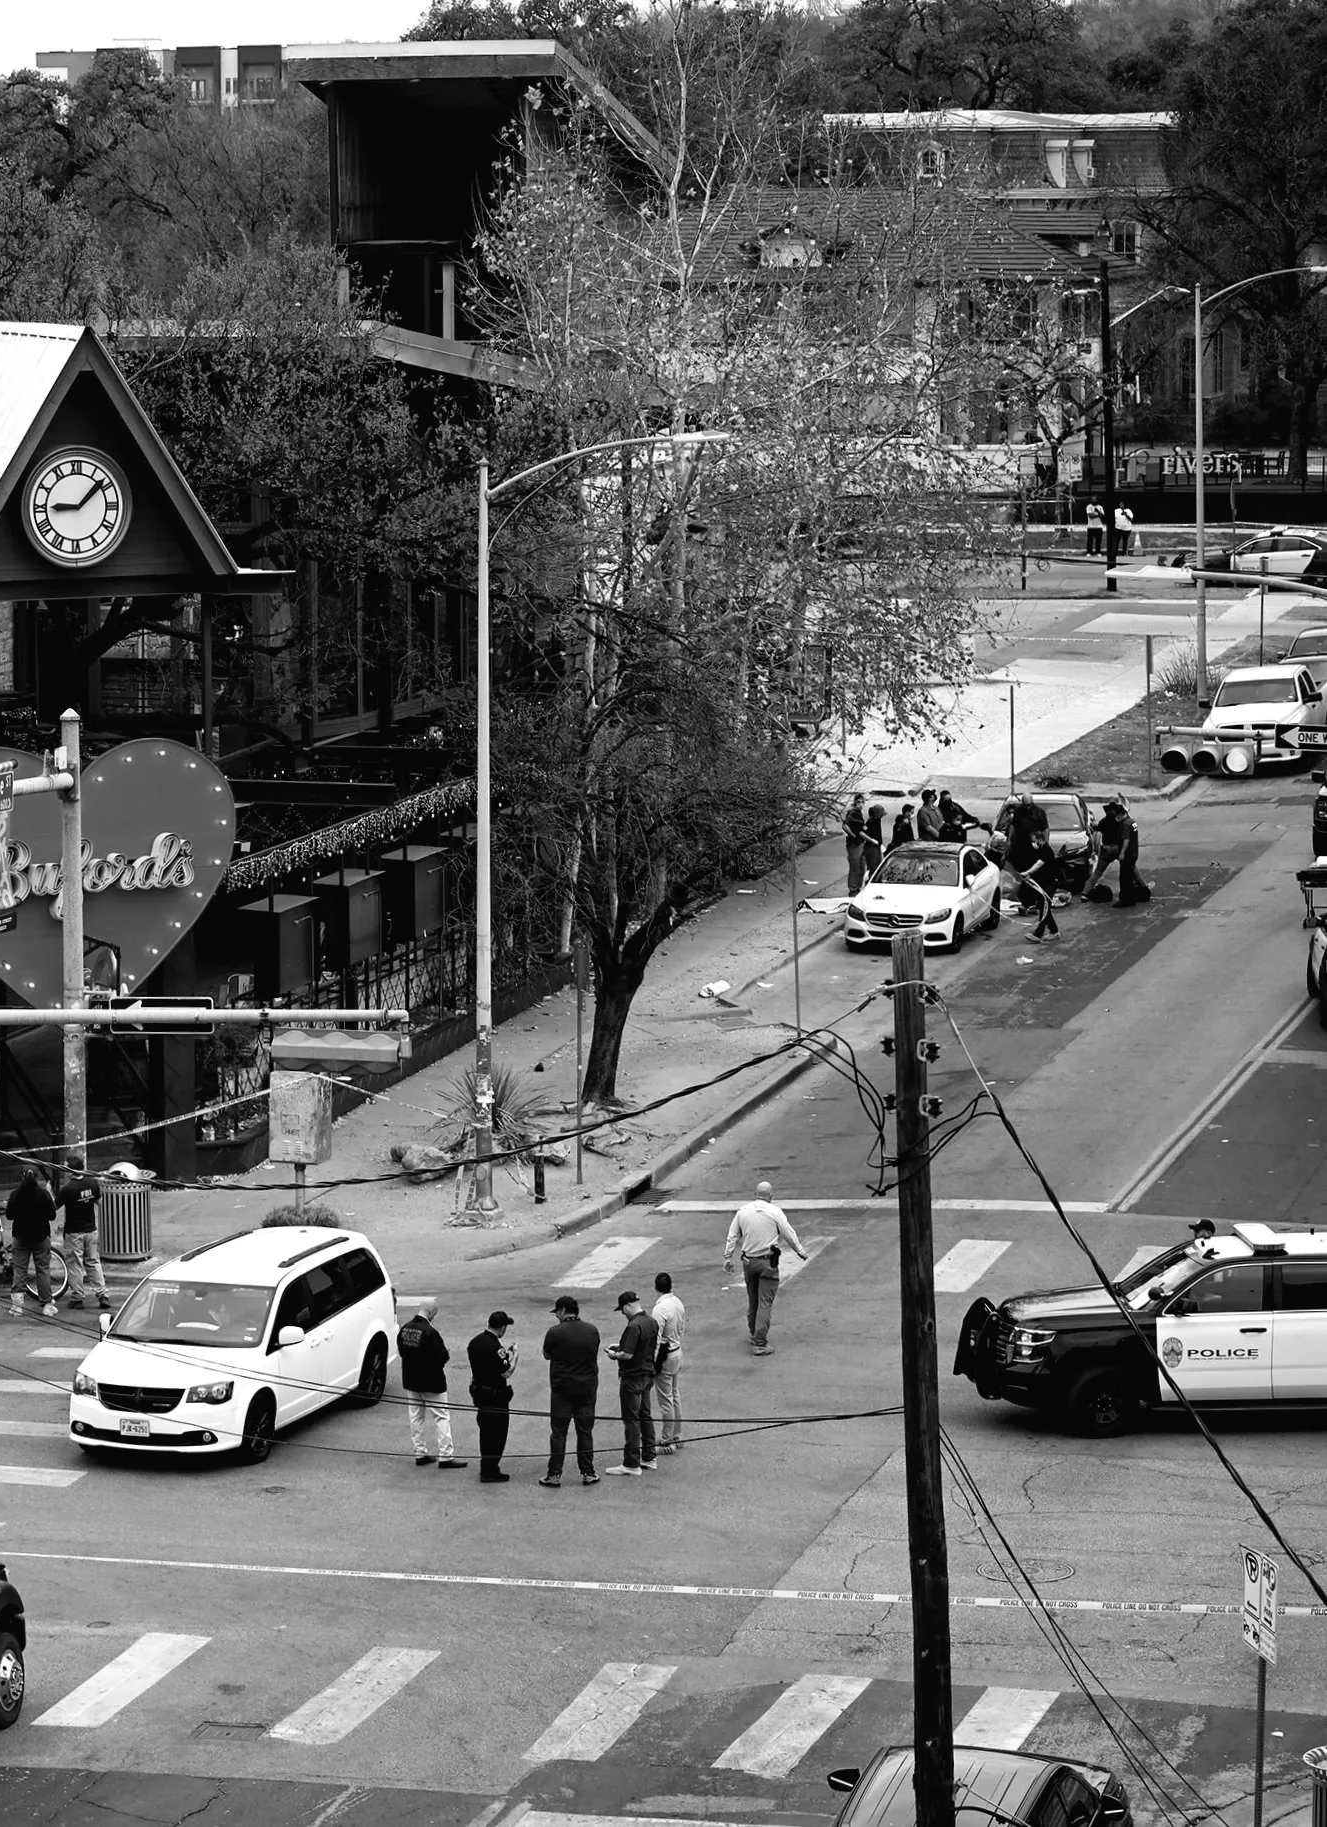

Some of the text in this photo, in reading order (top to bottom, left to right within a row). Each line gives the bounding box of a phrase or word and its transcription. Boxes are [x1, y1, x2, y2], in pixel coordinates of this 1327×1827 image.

[1298, 732, 1319, 743] ONE
[81, 1189, 93, 1198] FBI
[1187, 1348, 1259, 1358] POLICE
[1148, 1603, 1160, 1611] NOT
[1206, 1605, 1241, 1614] POLICE LINE
[1310, 1608, 1327, 1616] POLIC
